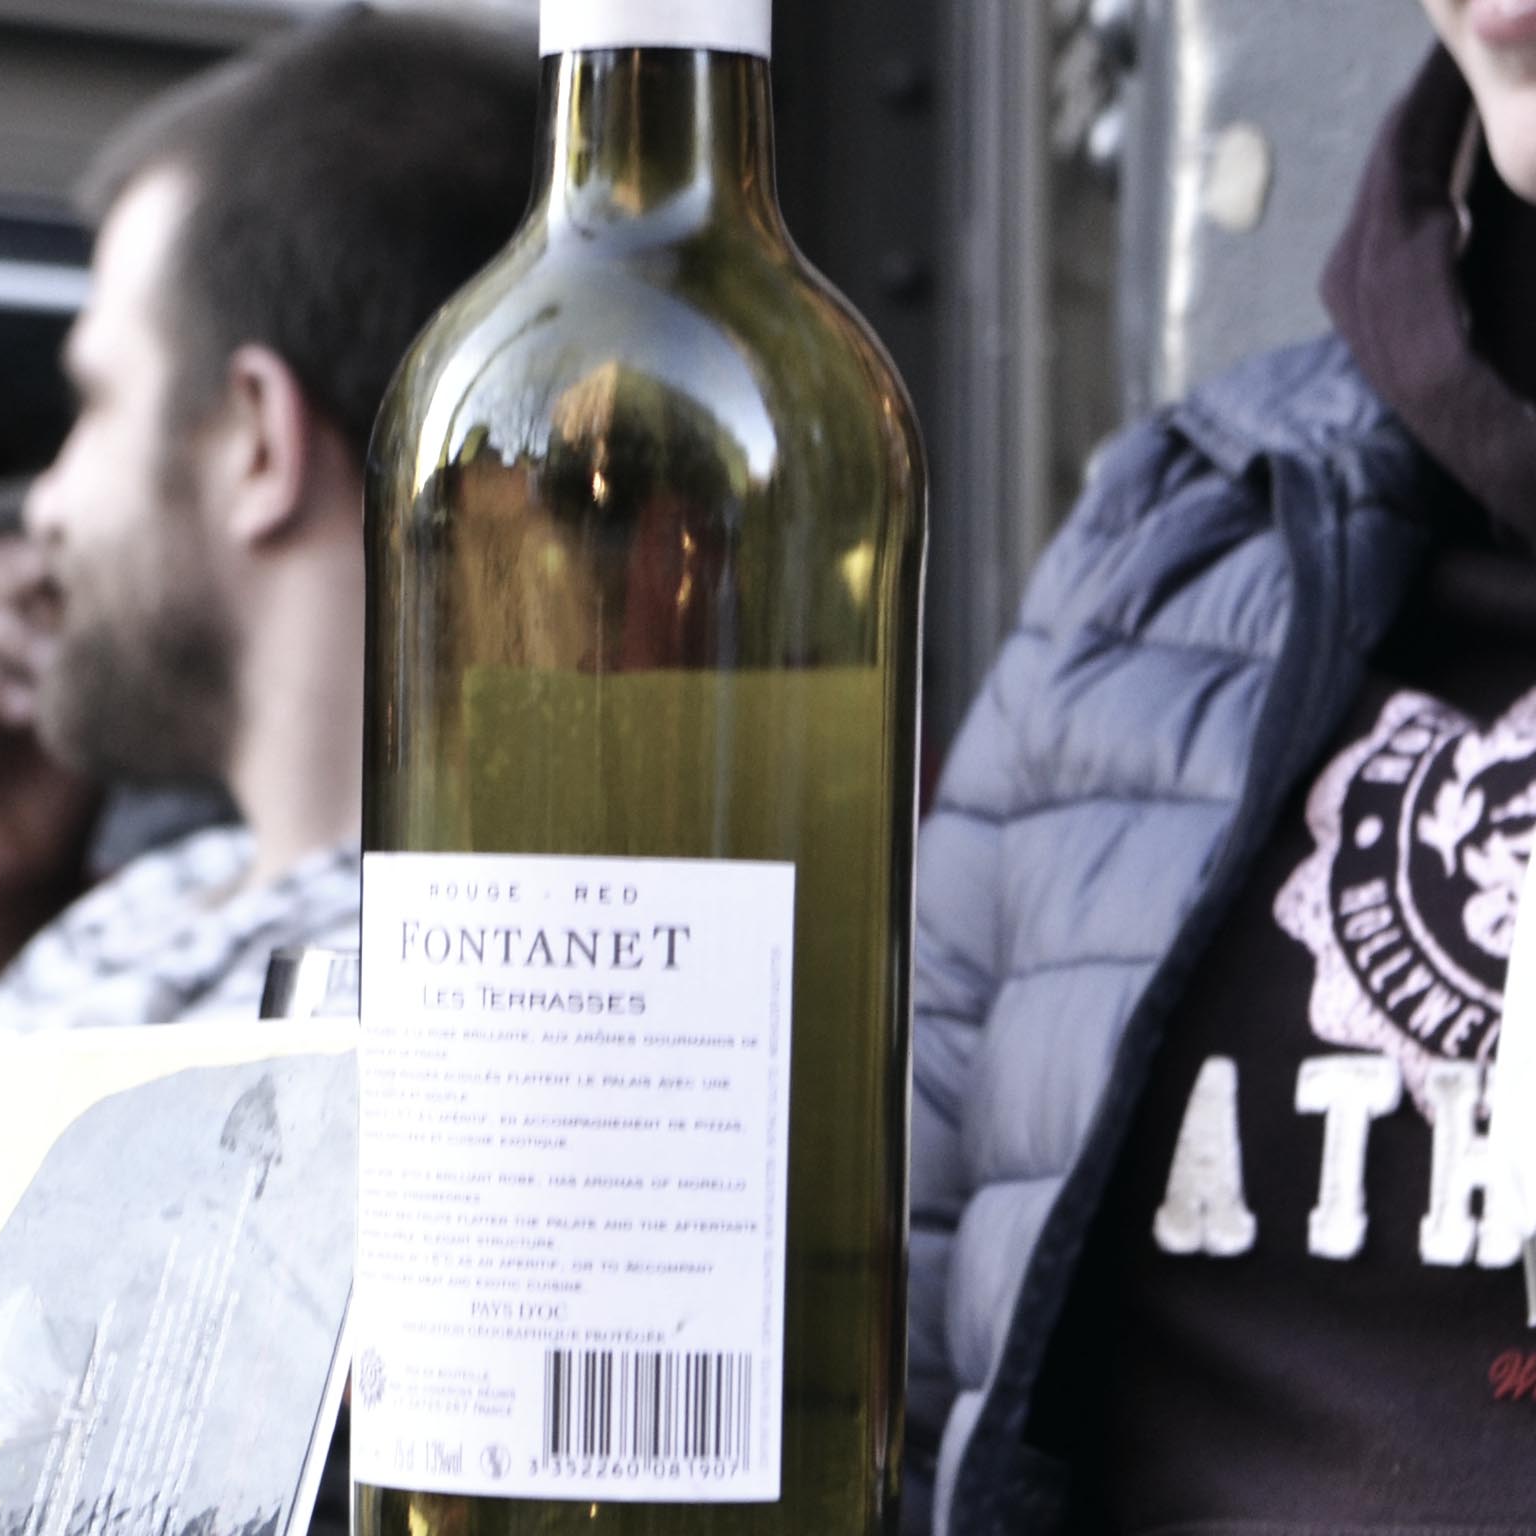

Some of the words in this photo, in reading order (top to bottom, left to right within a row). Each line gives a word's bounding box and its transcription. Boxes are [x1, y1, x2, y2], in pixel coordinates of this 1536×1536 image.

[429, 882, 521, 903] ROUGE
[574, 885, 639, 906] RED
[401, 920, 691, 970] FONTANET
[422, 985, 465, 1010] LES
[480, 984, 647, 1015] TERRASSES
[471, 1301, 513, 1318] PAYS
